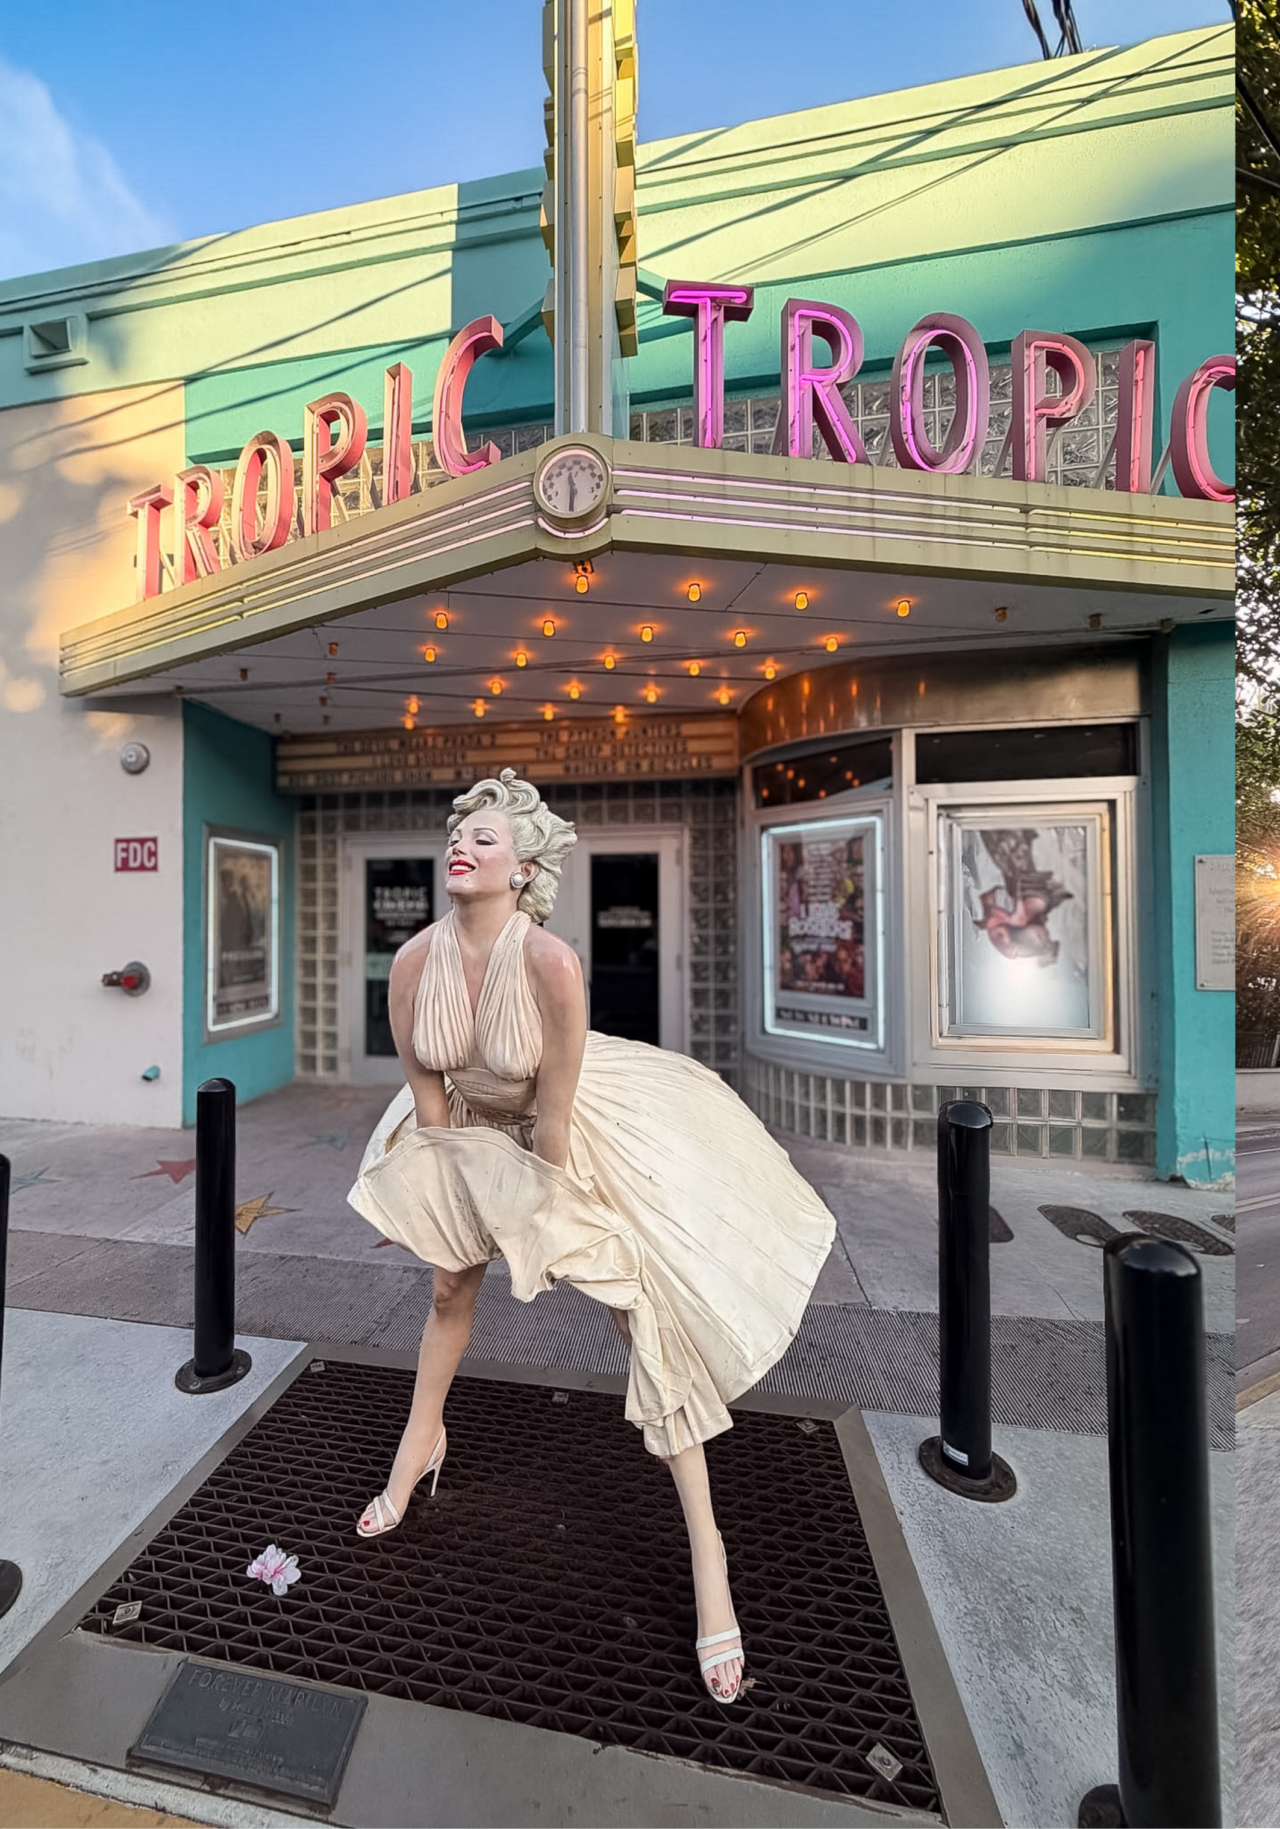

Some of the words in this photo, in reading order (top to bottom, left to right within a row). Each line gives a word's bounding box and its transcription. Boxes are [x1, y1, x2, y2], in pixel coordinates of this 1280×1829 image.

[663, 279, 1235, 503] TROPIC
[127, 314, 503, 600] TROPIC
[116, 841, 156, 869] FDC
[372, 886, 428, 899] TROPIC
[267, 1685, 345, 1720] MARILYN
